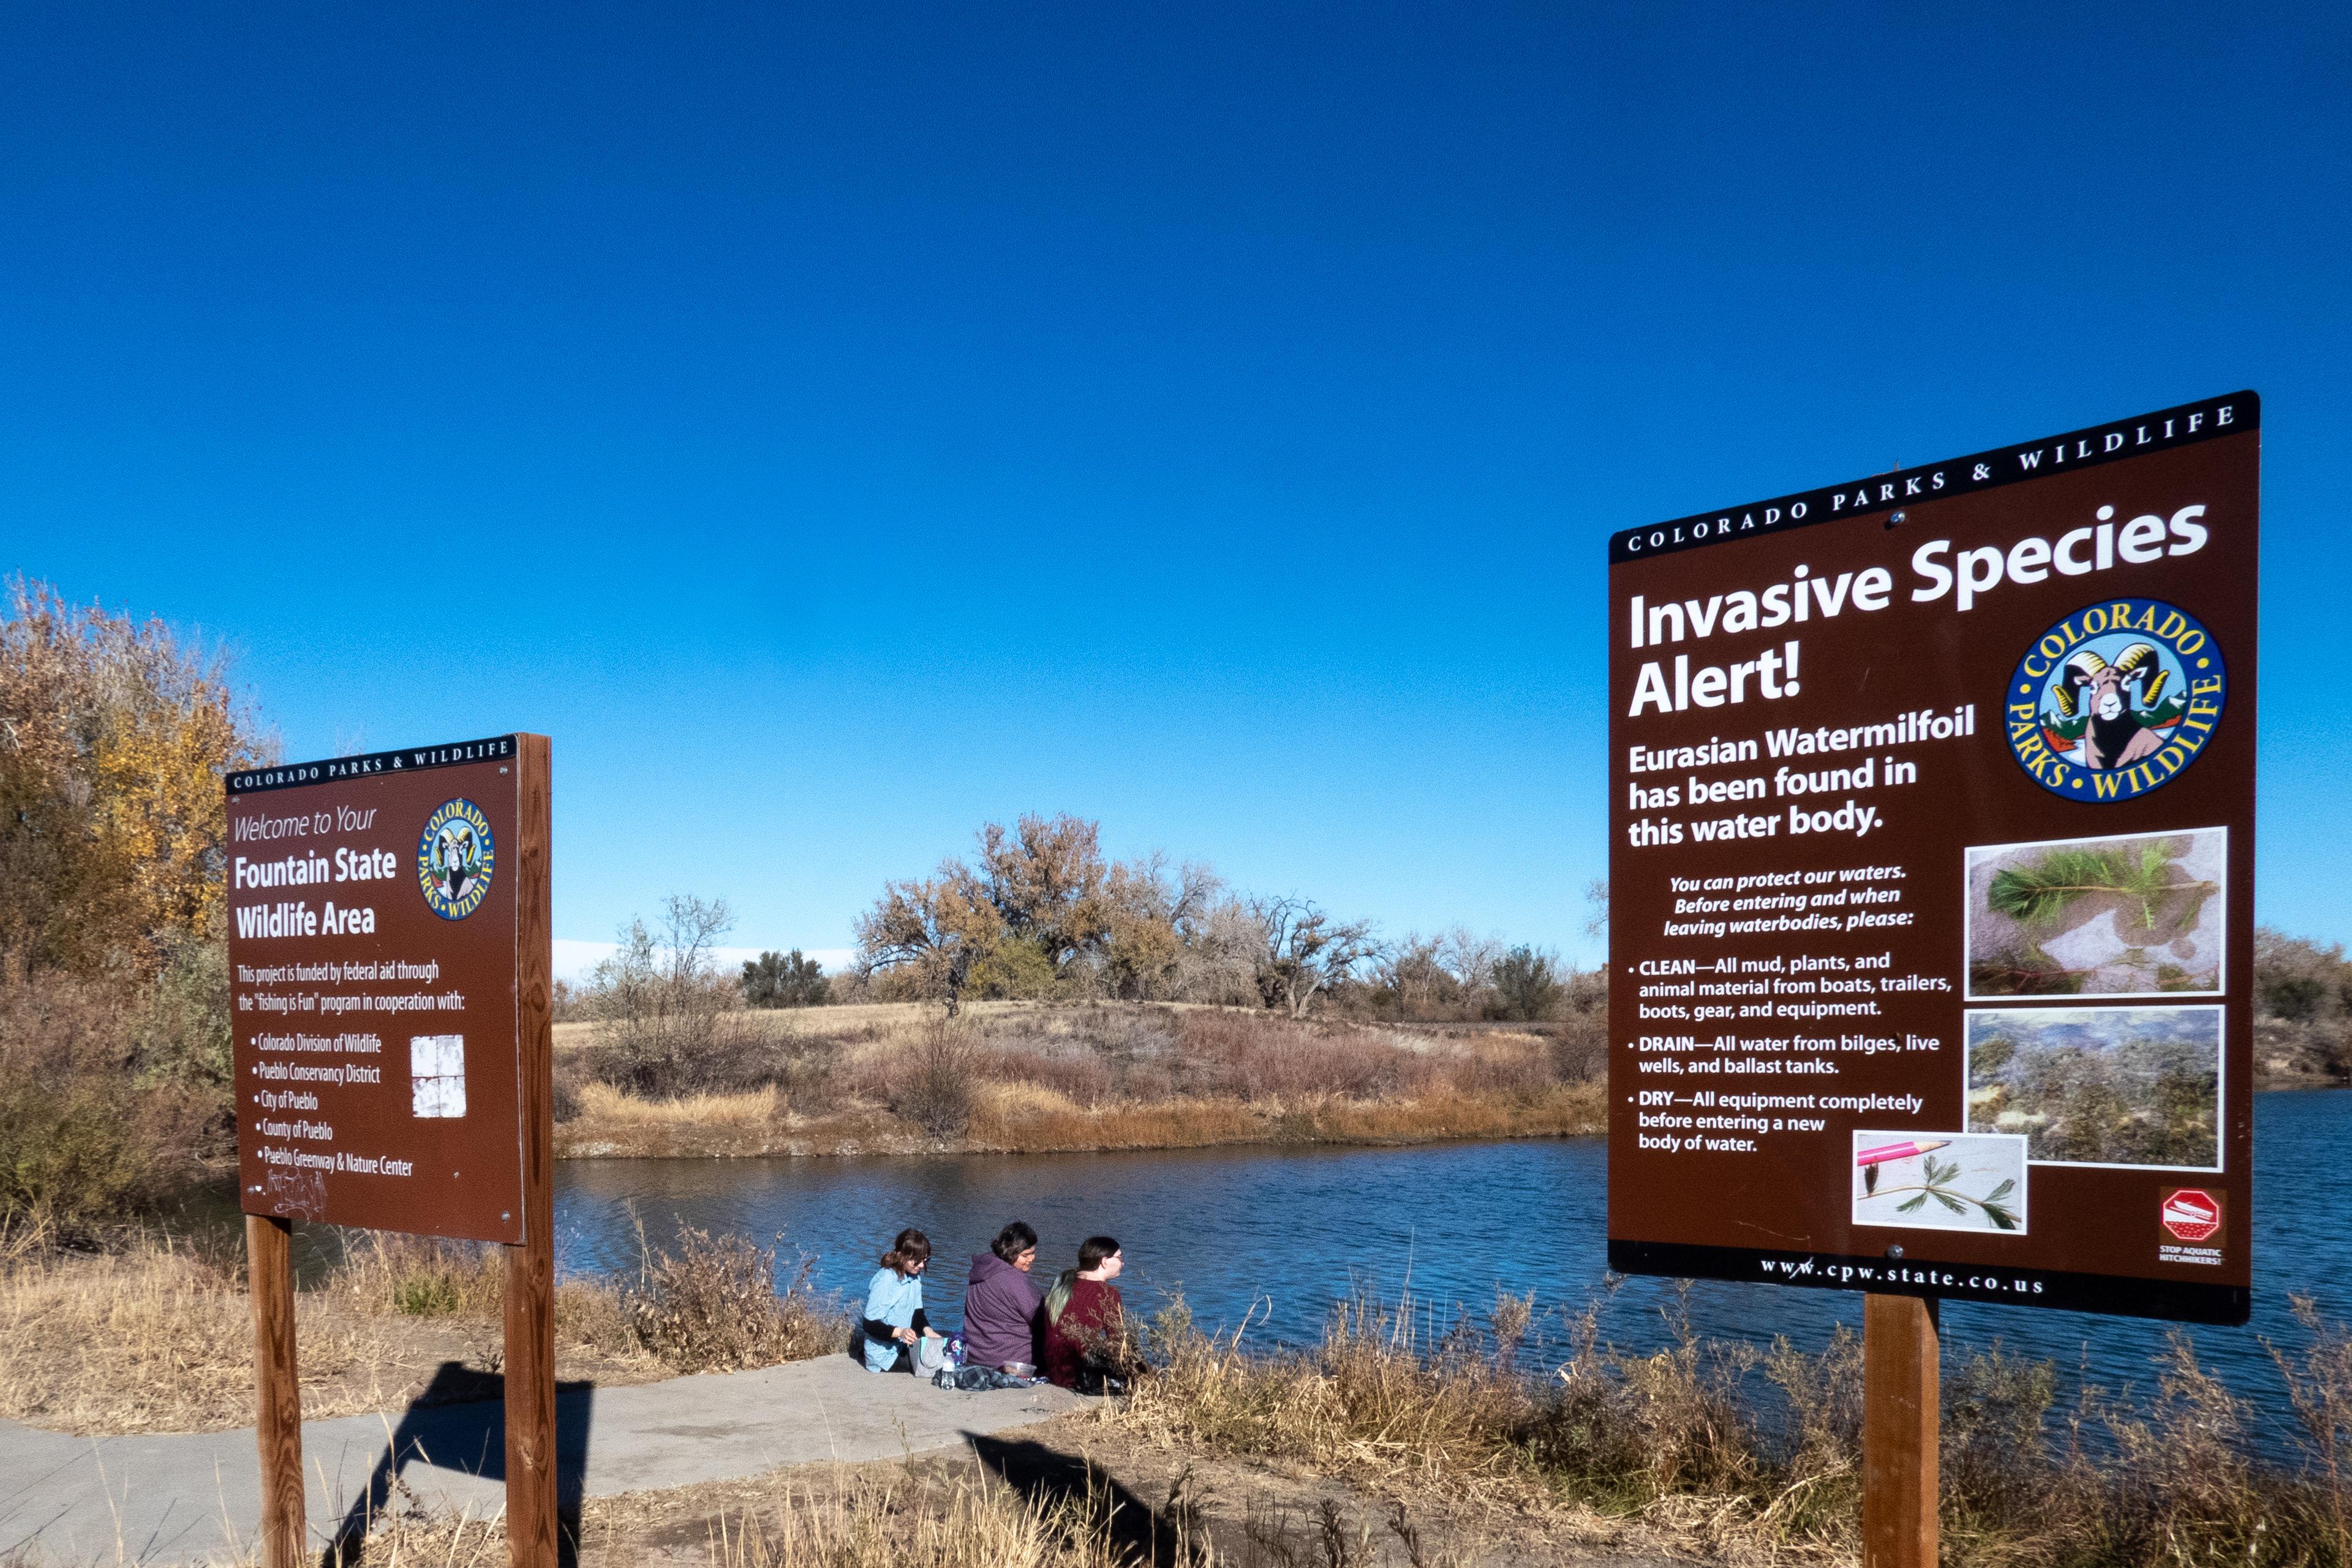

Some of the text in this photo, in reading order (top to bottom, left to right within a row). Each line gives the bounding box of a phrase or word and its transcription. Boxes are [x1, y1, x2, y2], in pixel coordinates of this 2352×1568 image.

[1629, 406, 2233, 551] COLORADO PARKS & WILDLIFE
[1631, 505, 2207, 649] Invasive Species
[2024, 603, 2205, 677] COLORADO
[1629, 641, 1800, 717] Alert!
[1630, 704, 1973, 772] Eurasian Watermilfoil
[2010, 702, 2070, 786] PARKS
[2092, 674, 2221, 798] WILDLIFE
[234, 742, 507, 788] COLORADO PARKS & WILDLIFE
[1630, 756, 1916, 810] has been found in
[236, 805, 377, 841] Welcome to Your
[424, 802, 489, 842] COLORADO
[1629, 800, 1882, 846] this water body.
[236, 848, 396, 889] Fountain State
[1671, 866, 1905, 892] You can protect our waters.
[418, 856, 442, 909] PARKS
[448, 850, 494, 918] WILDLIFE
[1675, 887, 1900, 913] Before entering and when
[236, 902, 374, 938] Wildlife Area
[1664, 911, 1913, 937] leaving waterbodies, please:
[237, 959, 439, 986] This project is funded by federal aid through
[1742, 956, 1785, 973] mud,
[1790, 955, 1850, 974] plants,
[1855, 952, 1890, 969] and
[1640, 974, 1951, 997] animal material from boats, trailers,
[239, 993, 253, 1011] the
[289, 993, 296, 1010] is
[298, 992, 318, 1010] Fun"
[321, 997, 360, 1015] program
[363, 993, 372, 1010] in
[375, 992, 434, 1015] cooperation
[437, 990, 464, 1009] with:
[1640, 1001, 1881, 1021] boots, gear, and equipment.
[258, 1033, 381, 1053] Colorado Division of Wildlife
[1740, 1038, 1789, 1051] water
[1793, 1035, 1836, 1050] from
[1841, 1035, 1901, 1055] bilges,
[1907, 1035, 1939, 1050] live
[259, 1061, 380, 1086] Pueblo Conservancy District
[1639, 1058, 1839, 1075] wells, and ballast tanks.
[261, 1090, 318, 1112] City of Pueblo
[1719, 1092, 1815, 1111] equipment
[1819, 1093, 1923, 1114] completely
[263, 1118, 333, 1141] County of Pueblo
[1640, 1112, 1825, 1134] before entering a new
[1640, 1133, 1757, 1153] body of water.
[265, 1146, 412, 1176] Pueblo Greenway & Nature Center
[2160, 1245, 2222, 1257] STOP AQUATIC
